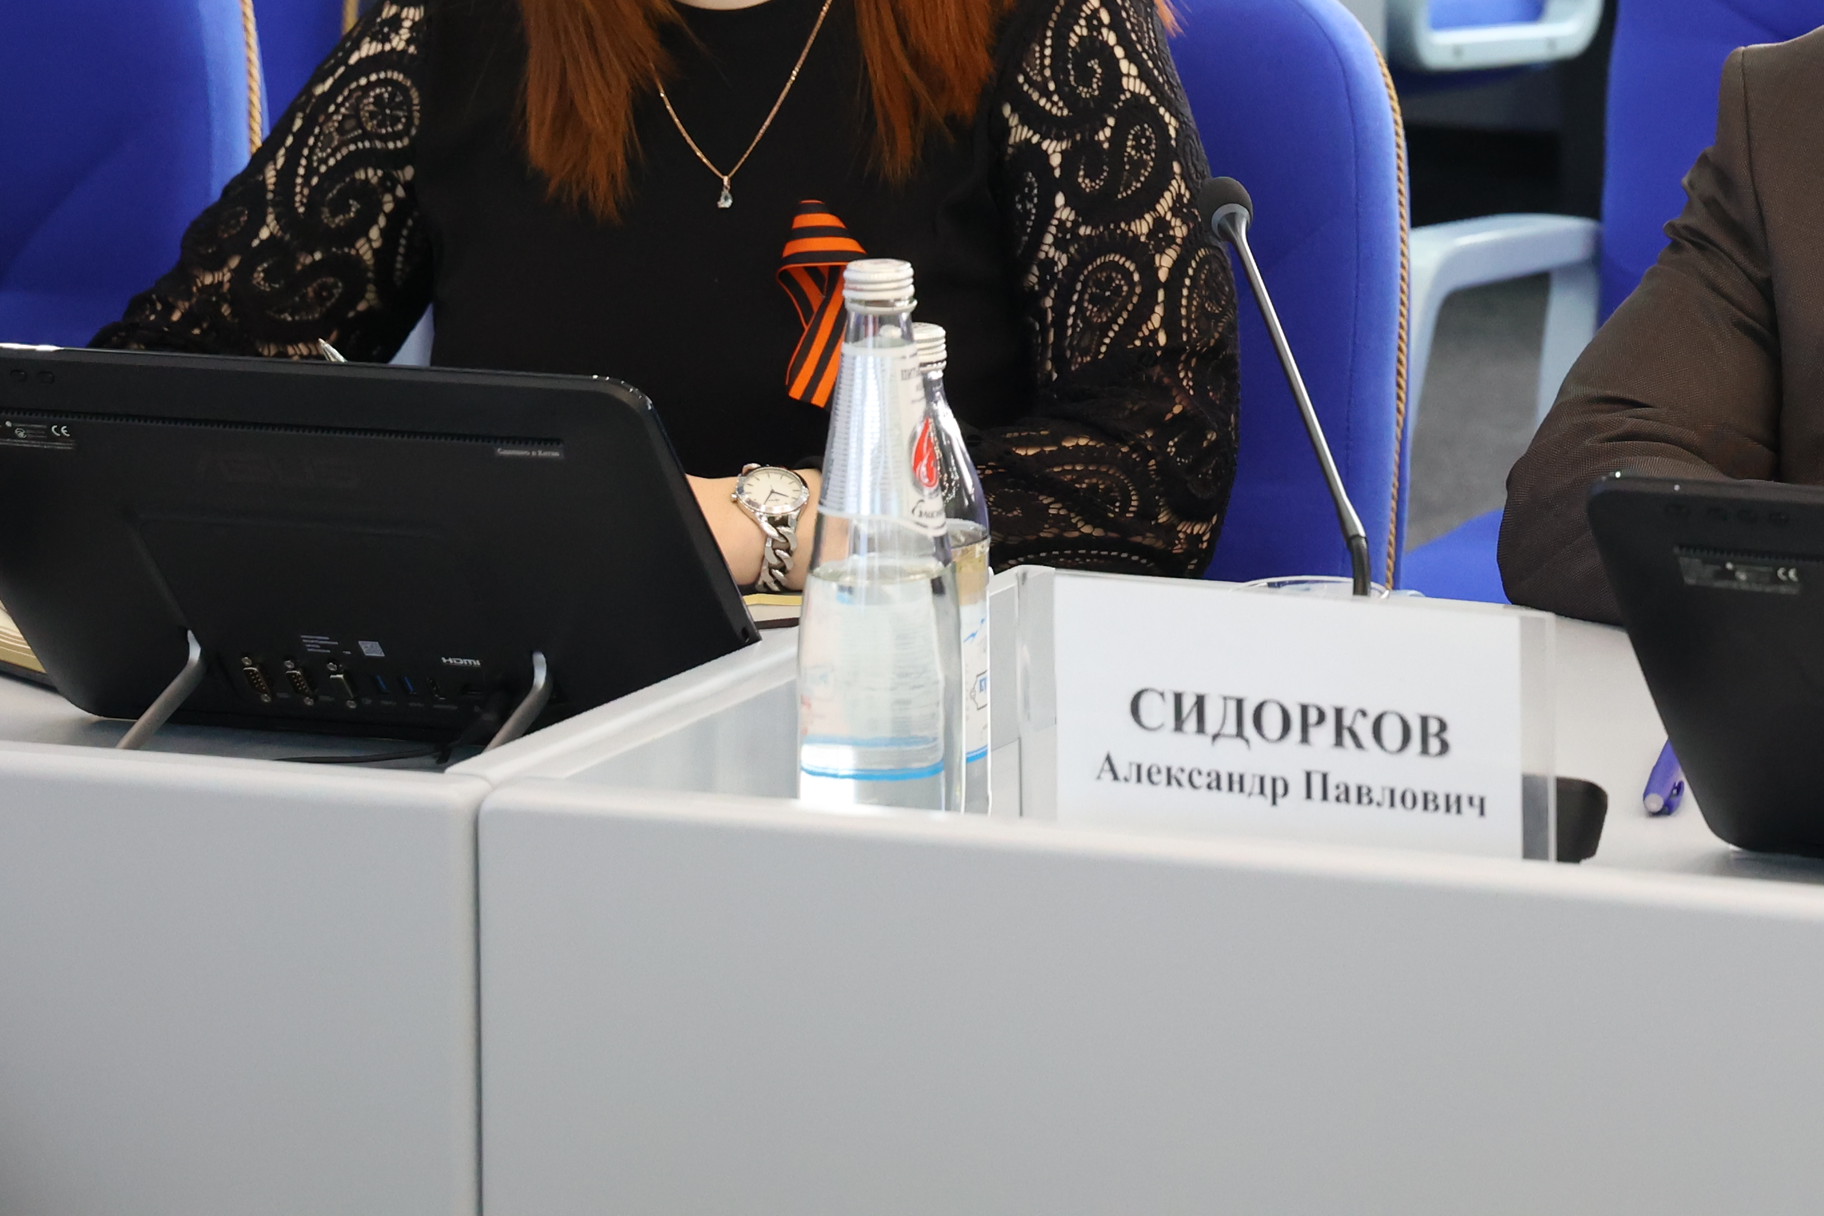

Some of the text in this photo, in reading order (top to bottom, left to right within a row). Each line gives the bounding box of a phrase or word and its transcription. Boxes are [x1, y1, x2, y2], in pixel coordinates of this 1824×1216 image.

[1129, 687, 1451, 758] СИДОРКОВ
[1096, 751, 1487, 818] Александр Павлович
